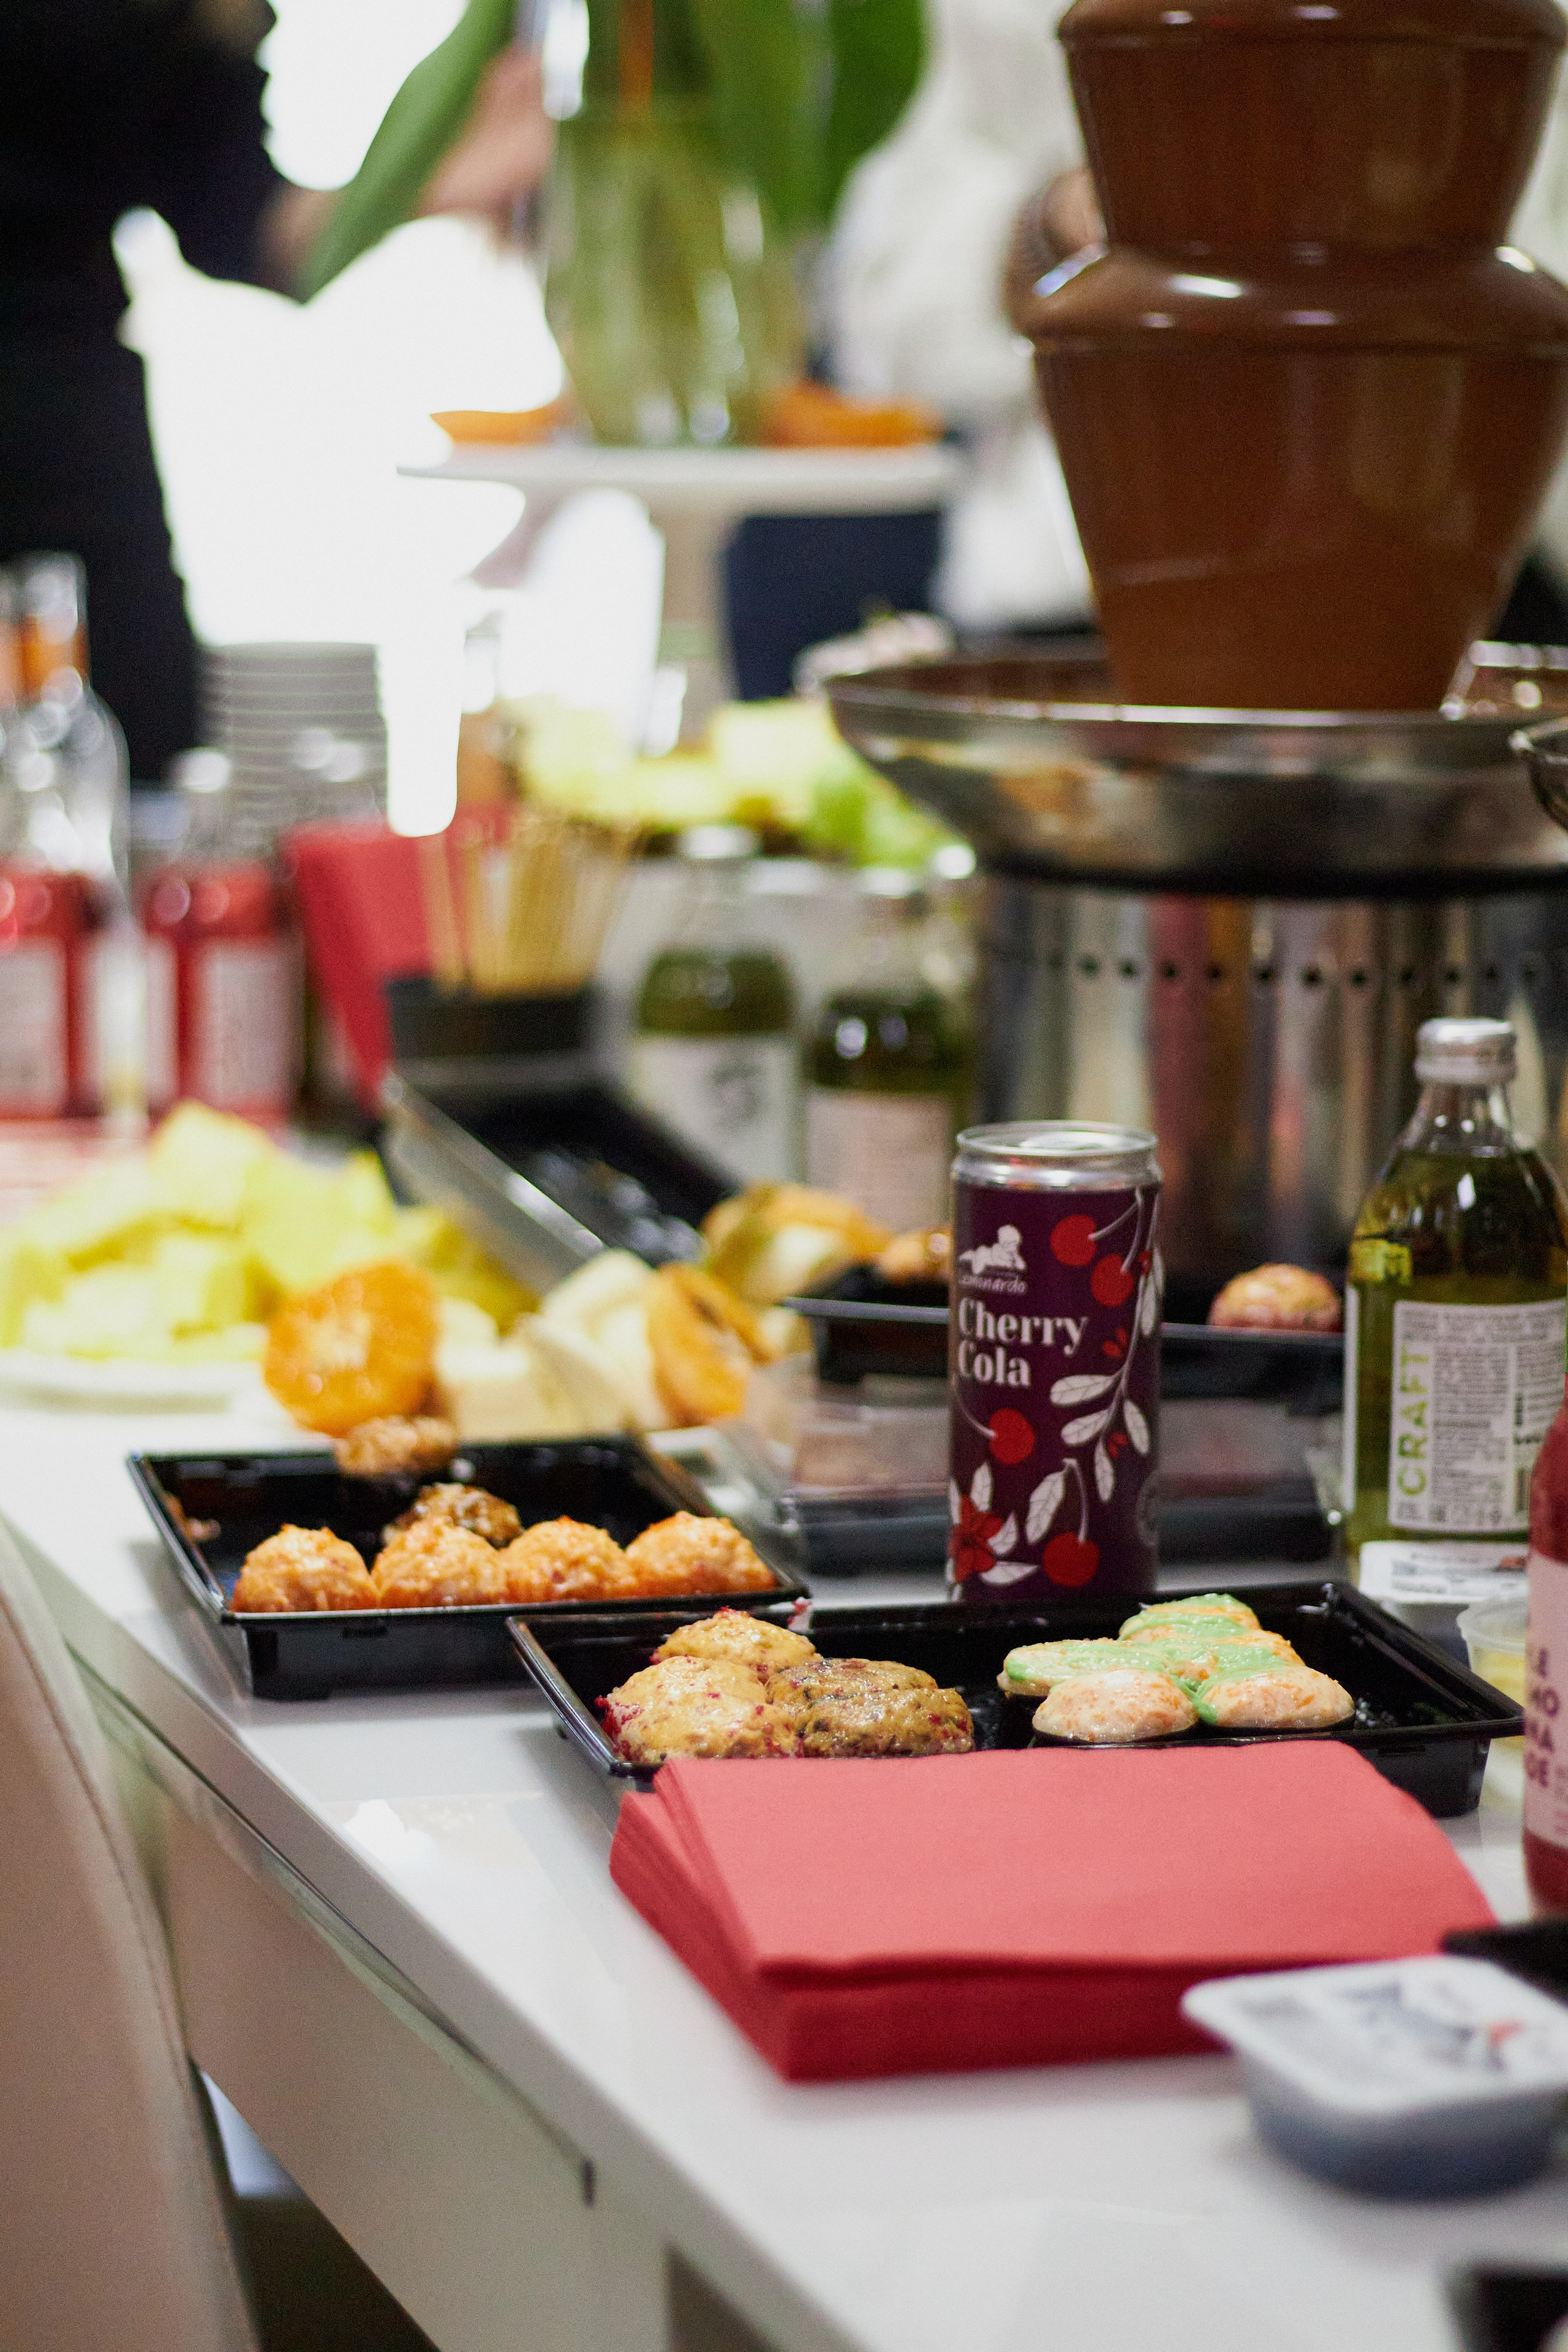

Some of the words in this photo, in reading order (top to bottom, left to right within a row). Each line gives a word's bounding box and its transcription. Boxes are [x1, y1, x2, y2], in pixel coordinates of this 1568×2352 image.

[959, 1297, 1088, 1357] Cherry
[959, 1340, 1030, 1389] Cola
[1396, 1344, 1429, 1496] CRAFT
